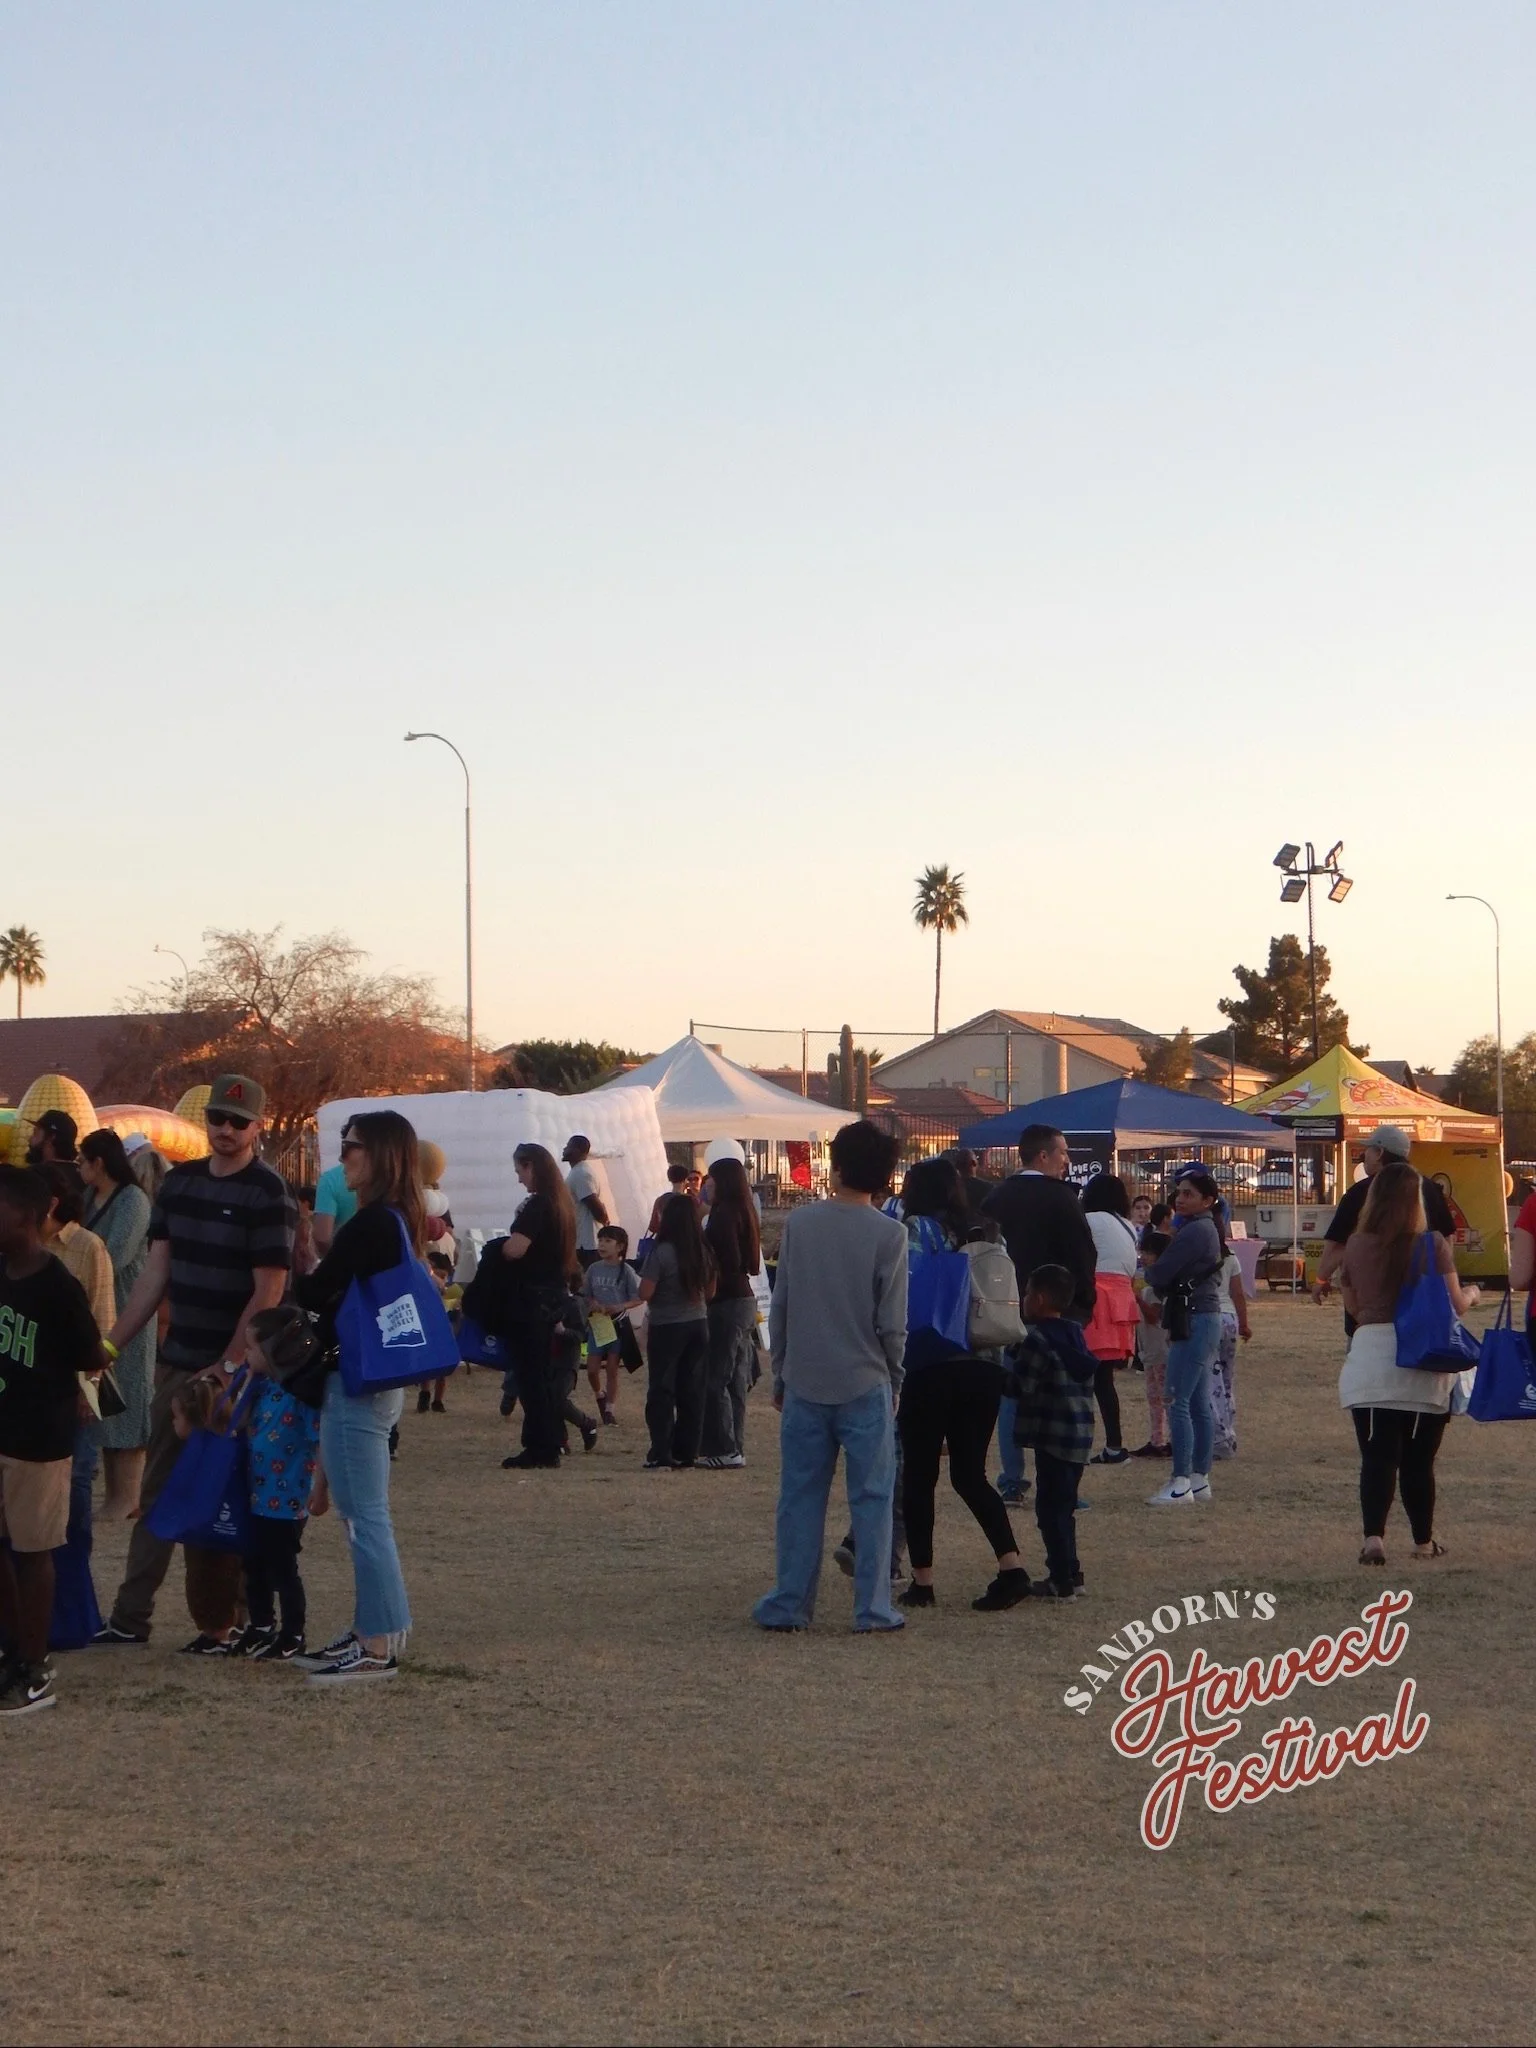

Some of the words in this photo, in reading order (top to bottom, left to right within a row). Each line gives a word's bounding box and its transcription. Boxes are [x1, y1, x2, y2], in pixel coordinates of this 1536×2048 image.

[224, 1083, 244, 1100] A
[1069, 1162, 1088, 1176] LOVE
[386, 1303, 411, 1319] WATER
[391, 1312, 403, 1324] USE
[387, 1316, 414, 1332] WISELY
